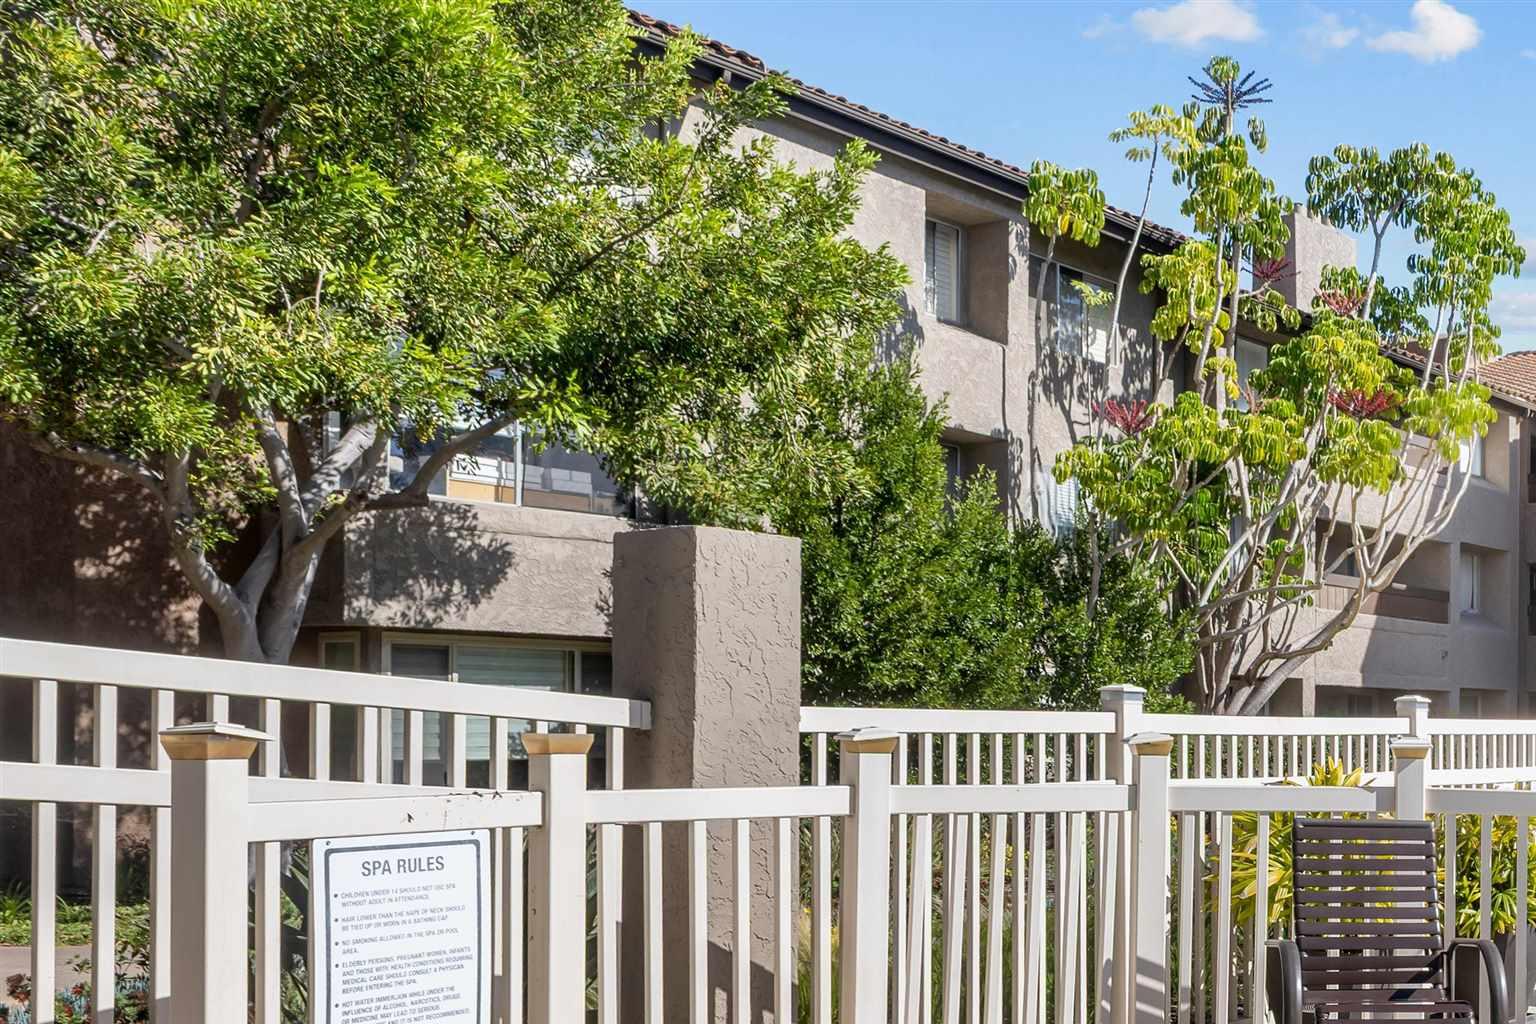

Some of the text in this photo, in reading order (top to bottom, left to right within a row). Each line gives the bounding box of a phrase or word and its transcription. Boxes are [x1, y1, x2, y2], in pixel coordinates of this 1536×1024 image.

[361, 856, 445, 877] SPA RULES
[342, 960, 366, 968] ELDERLY
[342, 977, 367, 985] MEDICAL
[409, 968, 432, 976] CONSULT
[342, 986, 364, 994] BEFORE
[366, 982, 392, 991] ENTERING
[342, 1007, 372, 1016] INFLUENCE
[352, 1014, 378, 1024] MEDICINE
